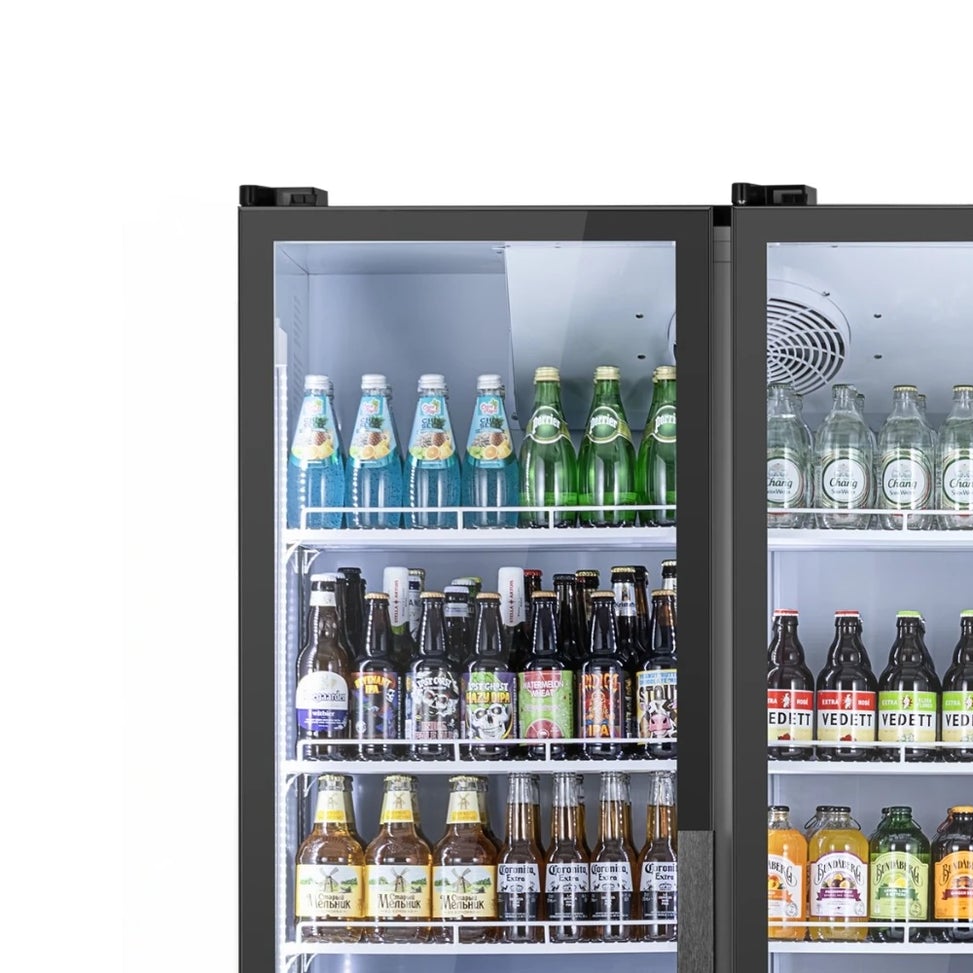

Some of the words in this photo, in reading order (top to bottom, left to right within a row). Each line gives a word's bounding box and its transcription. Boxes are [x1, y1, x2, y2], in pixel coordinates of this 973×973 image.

[532, 414, 560, 435] perrier
[589, 414, 618, 435] perrier
[888, 478, 917, 490] Chang
[822, 712, 872, 727] VEDETT
[882, 712, 932, 727] VEDETT
[507, 873, 525, 882] Extra
